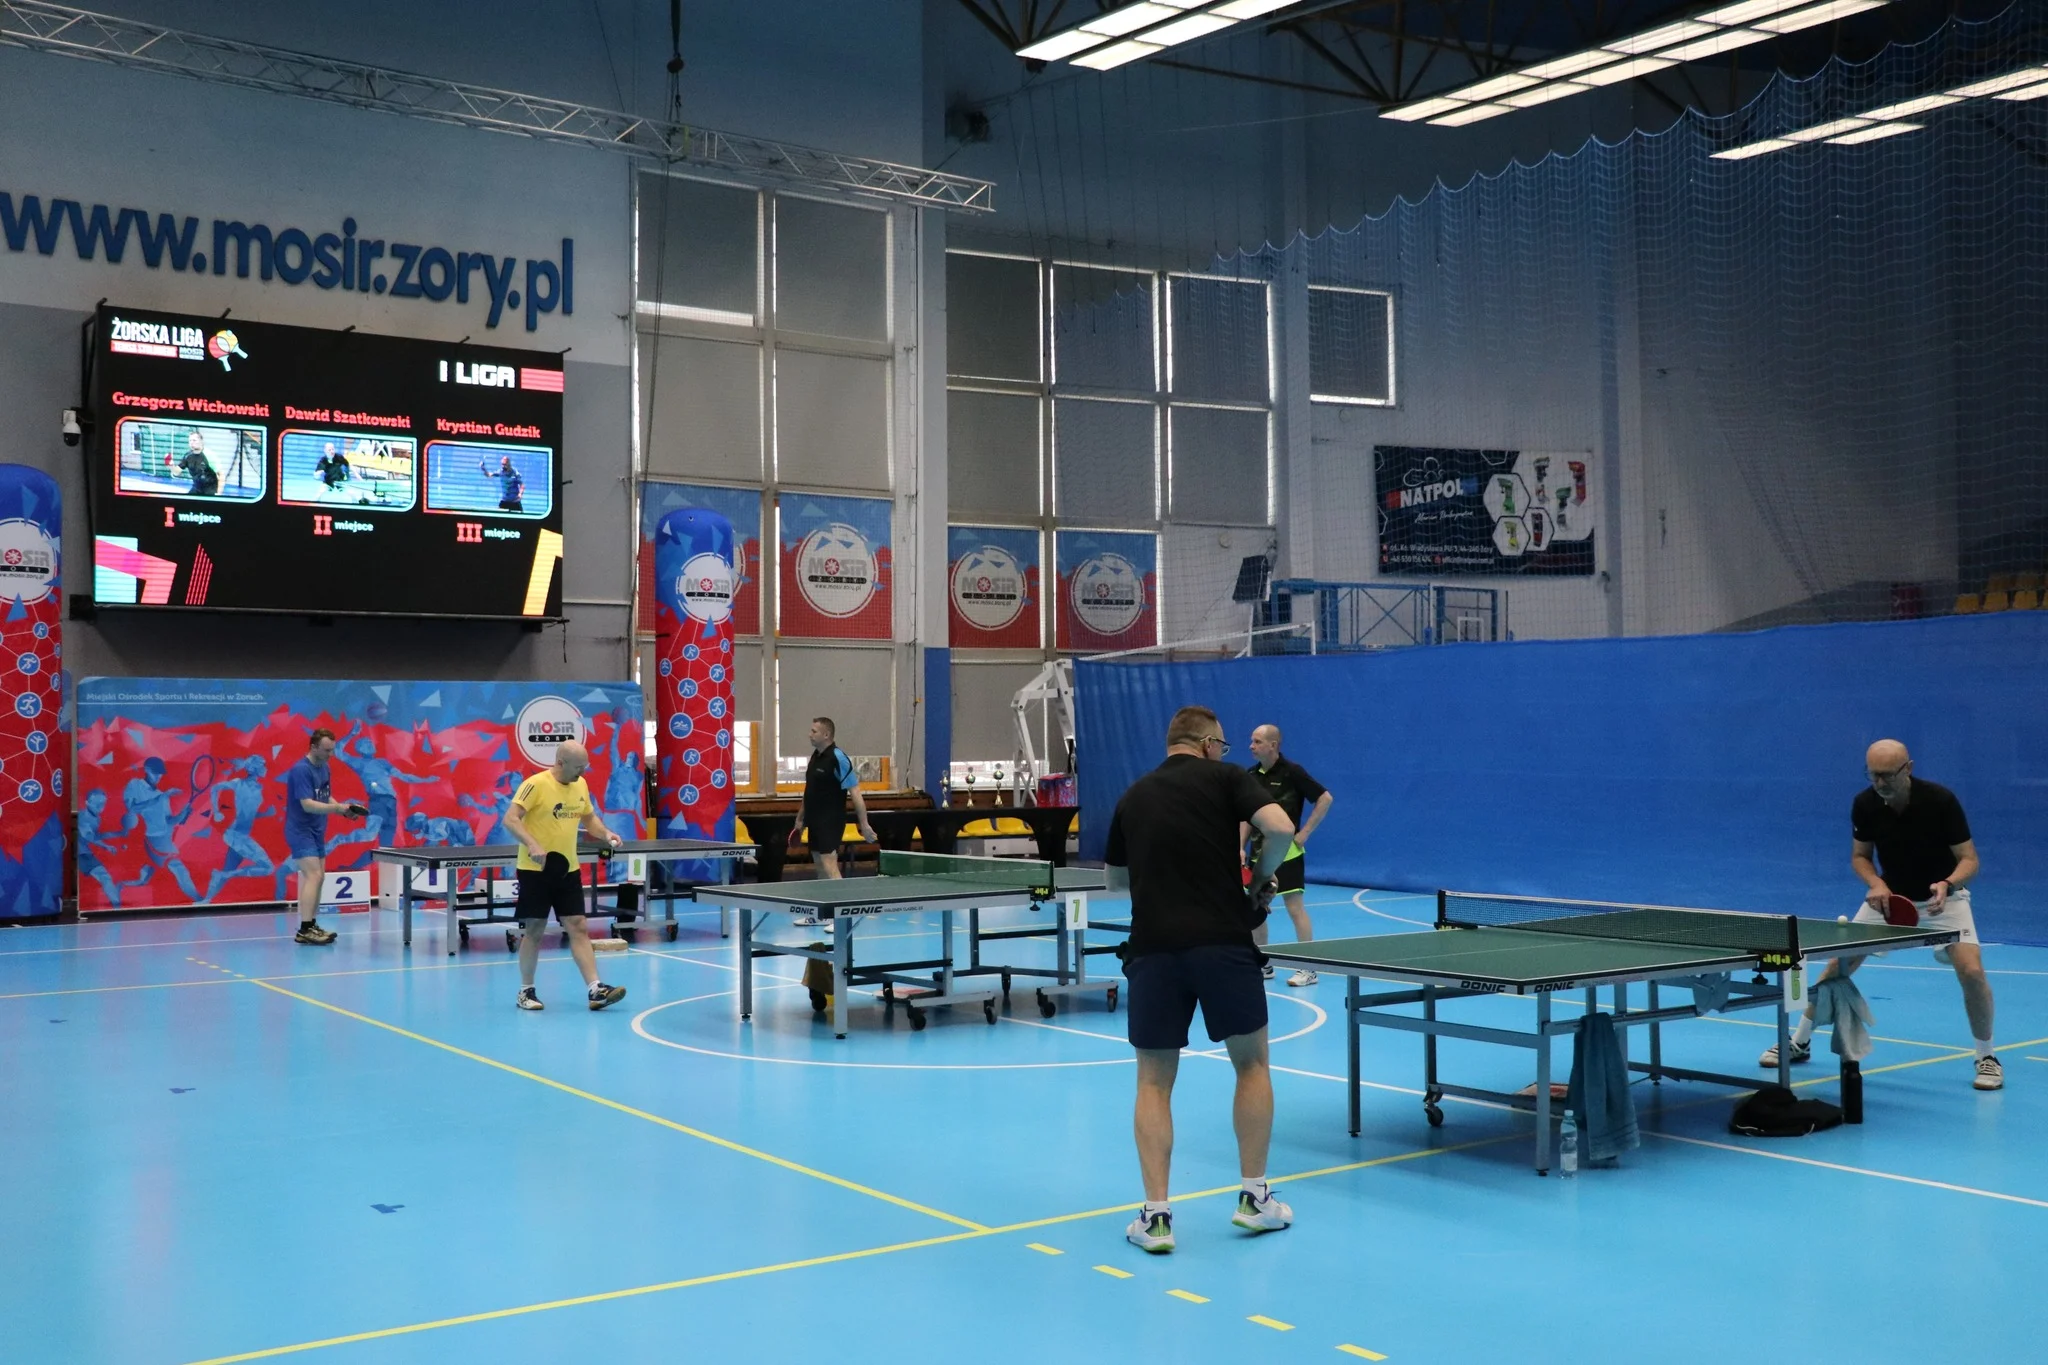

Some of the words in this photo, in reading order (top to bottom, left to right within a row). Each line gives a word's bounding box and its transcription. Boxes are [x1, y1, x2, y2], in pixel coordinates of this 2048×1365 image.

[0, 191, 574, 332] www.mosir.zory.pl
[111, 317, 170, 344] ŻORSKA
[172, 326, 204, 347] LIGA
[439, 360, 448, 382] I
[456, 362, 515, 388] LIGA
[112, 391, 184, 411] Grzegorz
[187, 397, 270, 417] Wichowski
[285, 406, 330, 422] Dawid
[333, 410, 411, 428] Szatkowski
[436, 418, 492, 435] Krystian
[494, 423, 541, 439] Gudzik
[1400, 478, 1464, 508] NATPOL
[164, 507, 175, 528] I
[178, 512, 221, 525] miejsce
[313, 515, 332, 535] II
[334, 520, 374, 533] miejsce
[456, 522, 482, 543] III
[484, 528, 520, 540] miejsce
[0, 549, 50, 567] OSiR
[808, 557, 867, 576] MOSiR
[685, 577, 730, 592] MOSiR
[528, 721, 575, 734] MOSiR
[335, 876, 353, 899] 2
[789, 905, 814, 915] DONIC
[840, 905, 883, 915] DONIC
[1460, 980, 1506, 993] DONIC
[1534, 981, 1575, 993] DONIC
